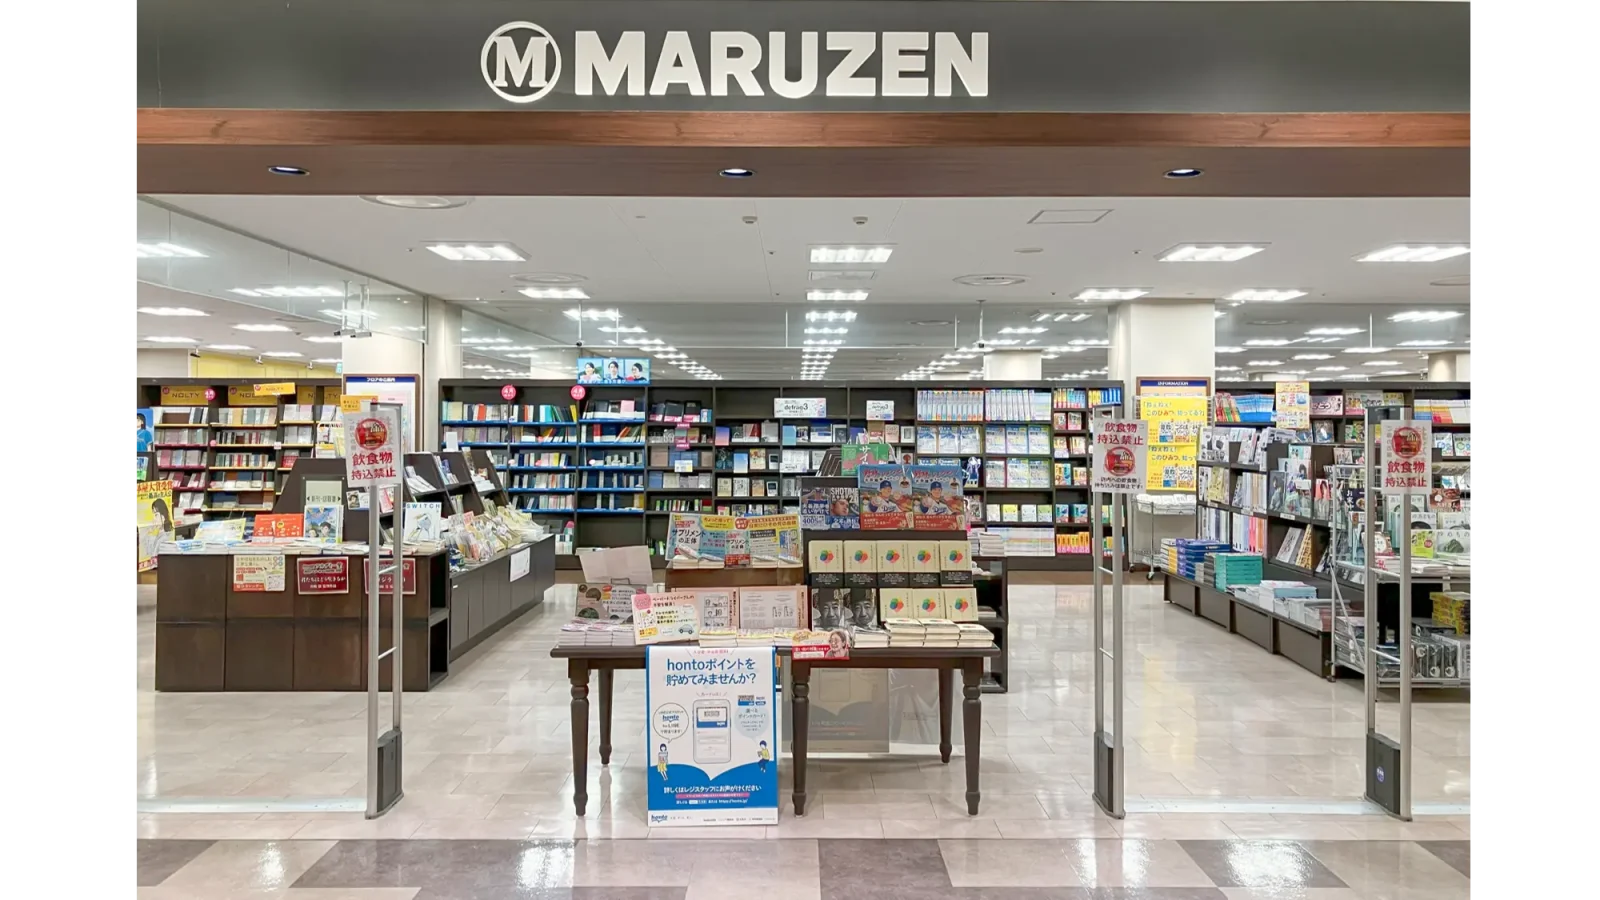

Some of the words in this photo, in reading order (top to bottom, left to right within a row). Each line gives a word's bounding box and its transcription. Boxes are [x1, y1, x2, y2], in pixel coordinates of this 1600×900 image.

[575, 31, 989, 97] MARUZEN
[1105, 422, 1137, 433] 飲食物
[1097, 434, 1144, 446] 持込禁止
[352, 452, 393, 466] 飲食物
[351, 467, 397, 480] 持込禁止
[1387, 460, 1426, 474] 飲食物
[1385, 477, 1427, 488] 持込禁止
[667, 658, 755, 671] hontoポイントを
[666, 673, 756, 686] 貯めてみませんか?
[663, 785, 762, 794] 詳しくはレジスタッフにお声がけください
